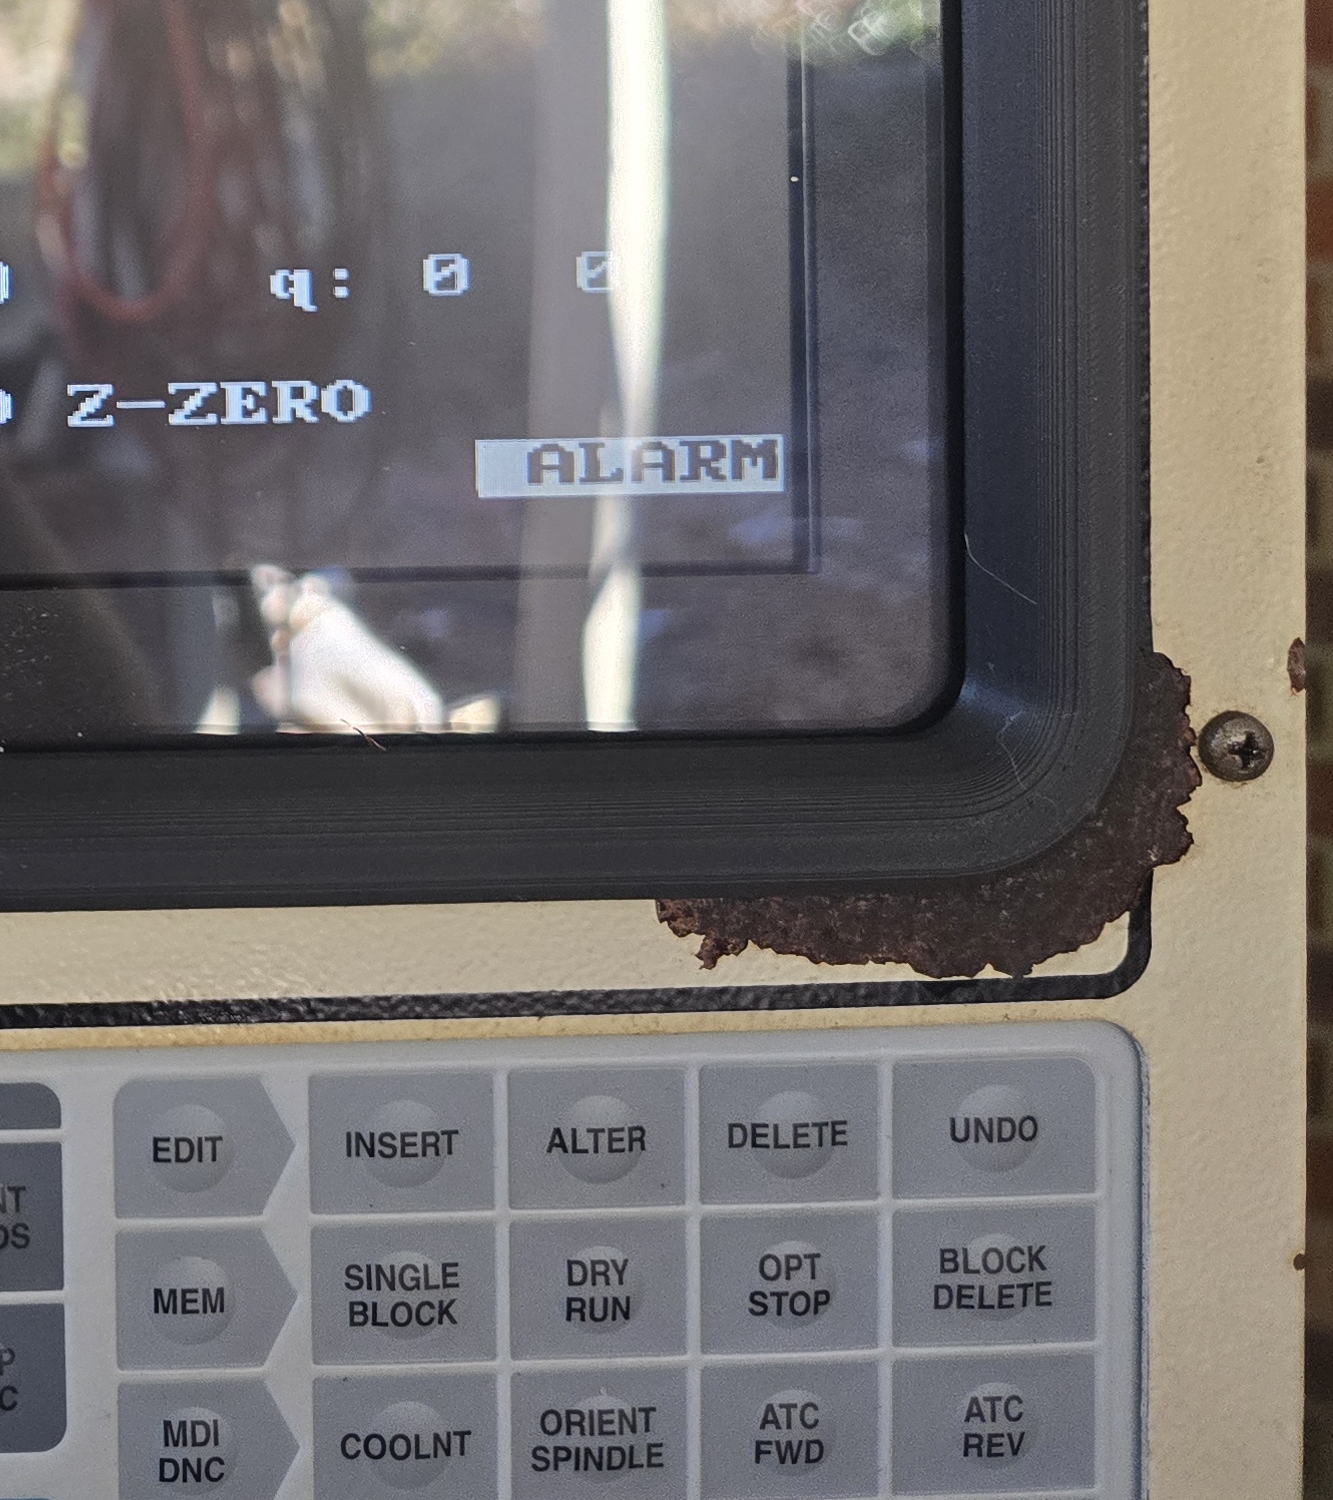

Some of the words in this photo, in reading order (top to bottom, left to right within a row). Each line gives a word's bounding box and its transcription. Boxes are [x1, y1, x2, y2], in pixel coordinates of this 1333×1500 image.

[269, 264, 351, 312] q:
[423, 253, 470, 295] 0
[66, 379, 371, 428] Z-ZERO
[527, 439, 779, 485] ALARM
[344, 1129, 459, 1160] INSERT
[546, 1125, 648, 1156] ALTER
[728, 1119, 848, 1151] DELETE
[948, 1114, 1039, 1144] UNDO
[152, 1135, 223, 1165] EDIT
[566, 1258, 629, 1289] DRY
[758, 1252, 821, 1284] OPT
[938, 1245, 1047, 1277] BLOCK
[343, 1261, 460, 1294] SINGLE
[153, 1286, 226, 1317] MEM
[348, 1296, 459, 1329] BLOCK
[565, 1294, 631, 1324] RUN
[748, 1288, 832, 1319] STOP
[932, 1281, 1053, 1313] DELETE
[539, 1406, 656, 1437] ORIENT
[758, 1401, 820, 1432] ATC
[963, 1394, 1025, 1426] ATC
[162, 1418, 221, 1449] MDI
[340, 1429, 471, 1463] COOLNT
[962, 1430, 1026, 1460] REV
[531, 1440, 665, 1473] SPINDLE
[753, 1436, 825, 1467] FWD
[158, 1454, 226, 1485] DNC
